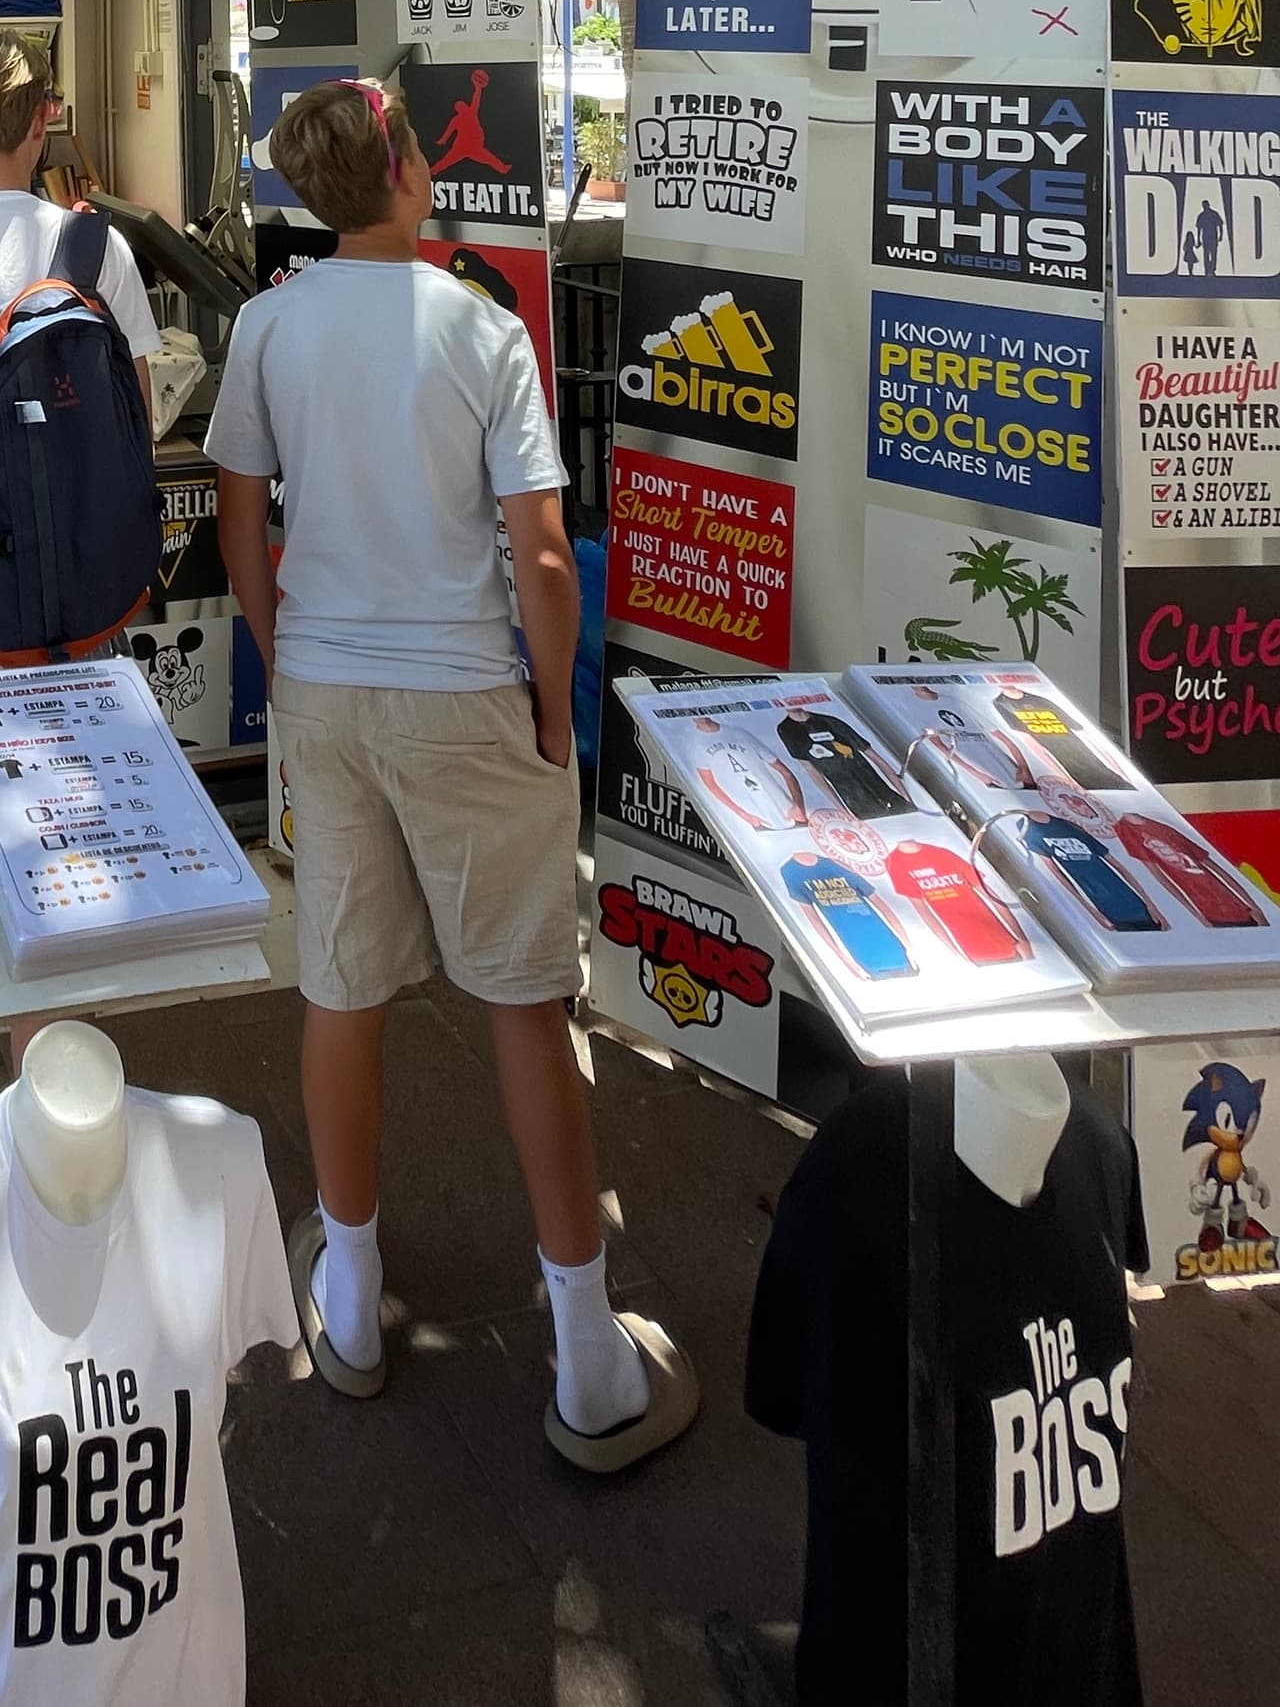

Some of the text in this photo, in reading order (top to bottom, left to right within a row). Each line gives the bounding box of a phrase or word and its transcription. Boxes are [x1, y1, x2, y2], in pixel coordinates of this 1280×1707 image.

[452, 22, 467, 33] JIM
[486, 21, 510, 32] JOSE
[666, 6, 775, 33] LATER...
[670, 94, 783, 120] TRIED TO
[890, 92, 1087, 128] WITH A
[1136, 111, 1169, 126] THE
[635, 117, 798, 171] RETIRE
[888, 123, 1088, 165] BODY
[1123, 128, 1280, 176] WALKING
[463, 182, 538, 217] EAT IT.
[634, 162, 798, 193] BUT NOW WORK FOR
[655, 177, 775, 222] MY WIFE
[887, 159, 1088, 216] LIKE
[886, 204, 1088, 263] THIS
[1124, 175, 1280, 277] DAD
[886, 245, 1088, 281] WHO NEEDS HAIR
[894, 322, 1090, 368] KNOW NOT
[1172, 336, 1258, 359] HAVE A
[619, 360, 796, 430] abirras
[879, 343, 1092, 410] PERFECT
[879, 379, 920, 400] BUT
[1135, 360, 1279, 403] Beautiful
[1139, 403, 1280, 429] DAUGHTER
[878, 405, 1091, 473] SO CLOSE
[1153, 432, 1280, 451] ALSO HAVE...
[878, 438, 1032, 486] IT SCARES ME
[1173, 457, 1234, 476] A GUN
[631, 471, 788, 526] DON'T HAVE A
[1173, 482, 1271, 502] A SHOVEL
[615, 489, 787, 559] Short Temper
[1173, 508, 1280, 527] & AN ALIBI
[624, 529, 786, 590] JUST HAVE A QUICK
[632, 554, 769, 610] REACTION TO
[628, 577, 764, 642] Bullshit
[1138, 604, 1280, 671] Cute
[24, 700, 65, 711] ESTAMPA
[1175, 665, 1227, 701] but
[48, 755, 92, 767] ESTAMPA
[620, 802, 648, 828] YOU
[621, 772, 693, 825] FLUFF
[635, 878, 738, 943] BRAWL
[599, 883, 774, 1007] STARS
[1177, 1240, 1278, 1279] SONIC
[1023, 1316, 1078, 1404] The
[65, 1358, 140, 1432] The
[18, 1389, 191, 1545] Real
[14, 1519, 183, 1648] BOSS
